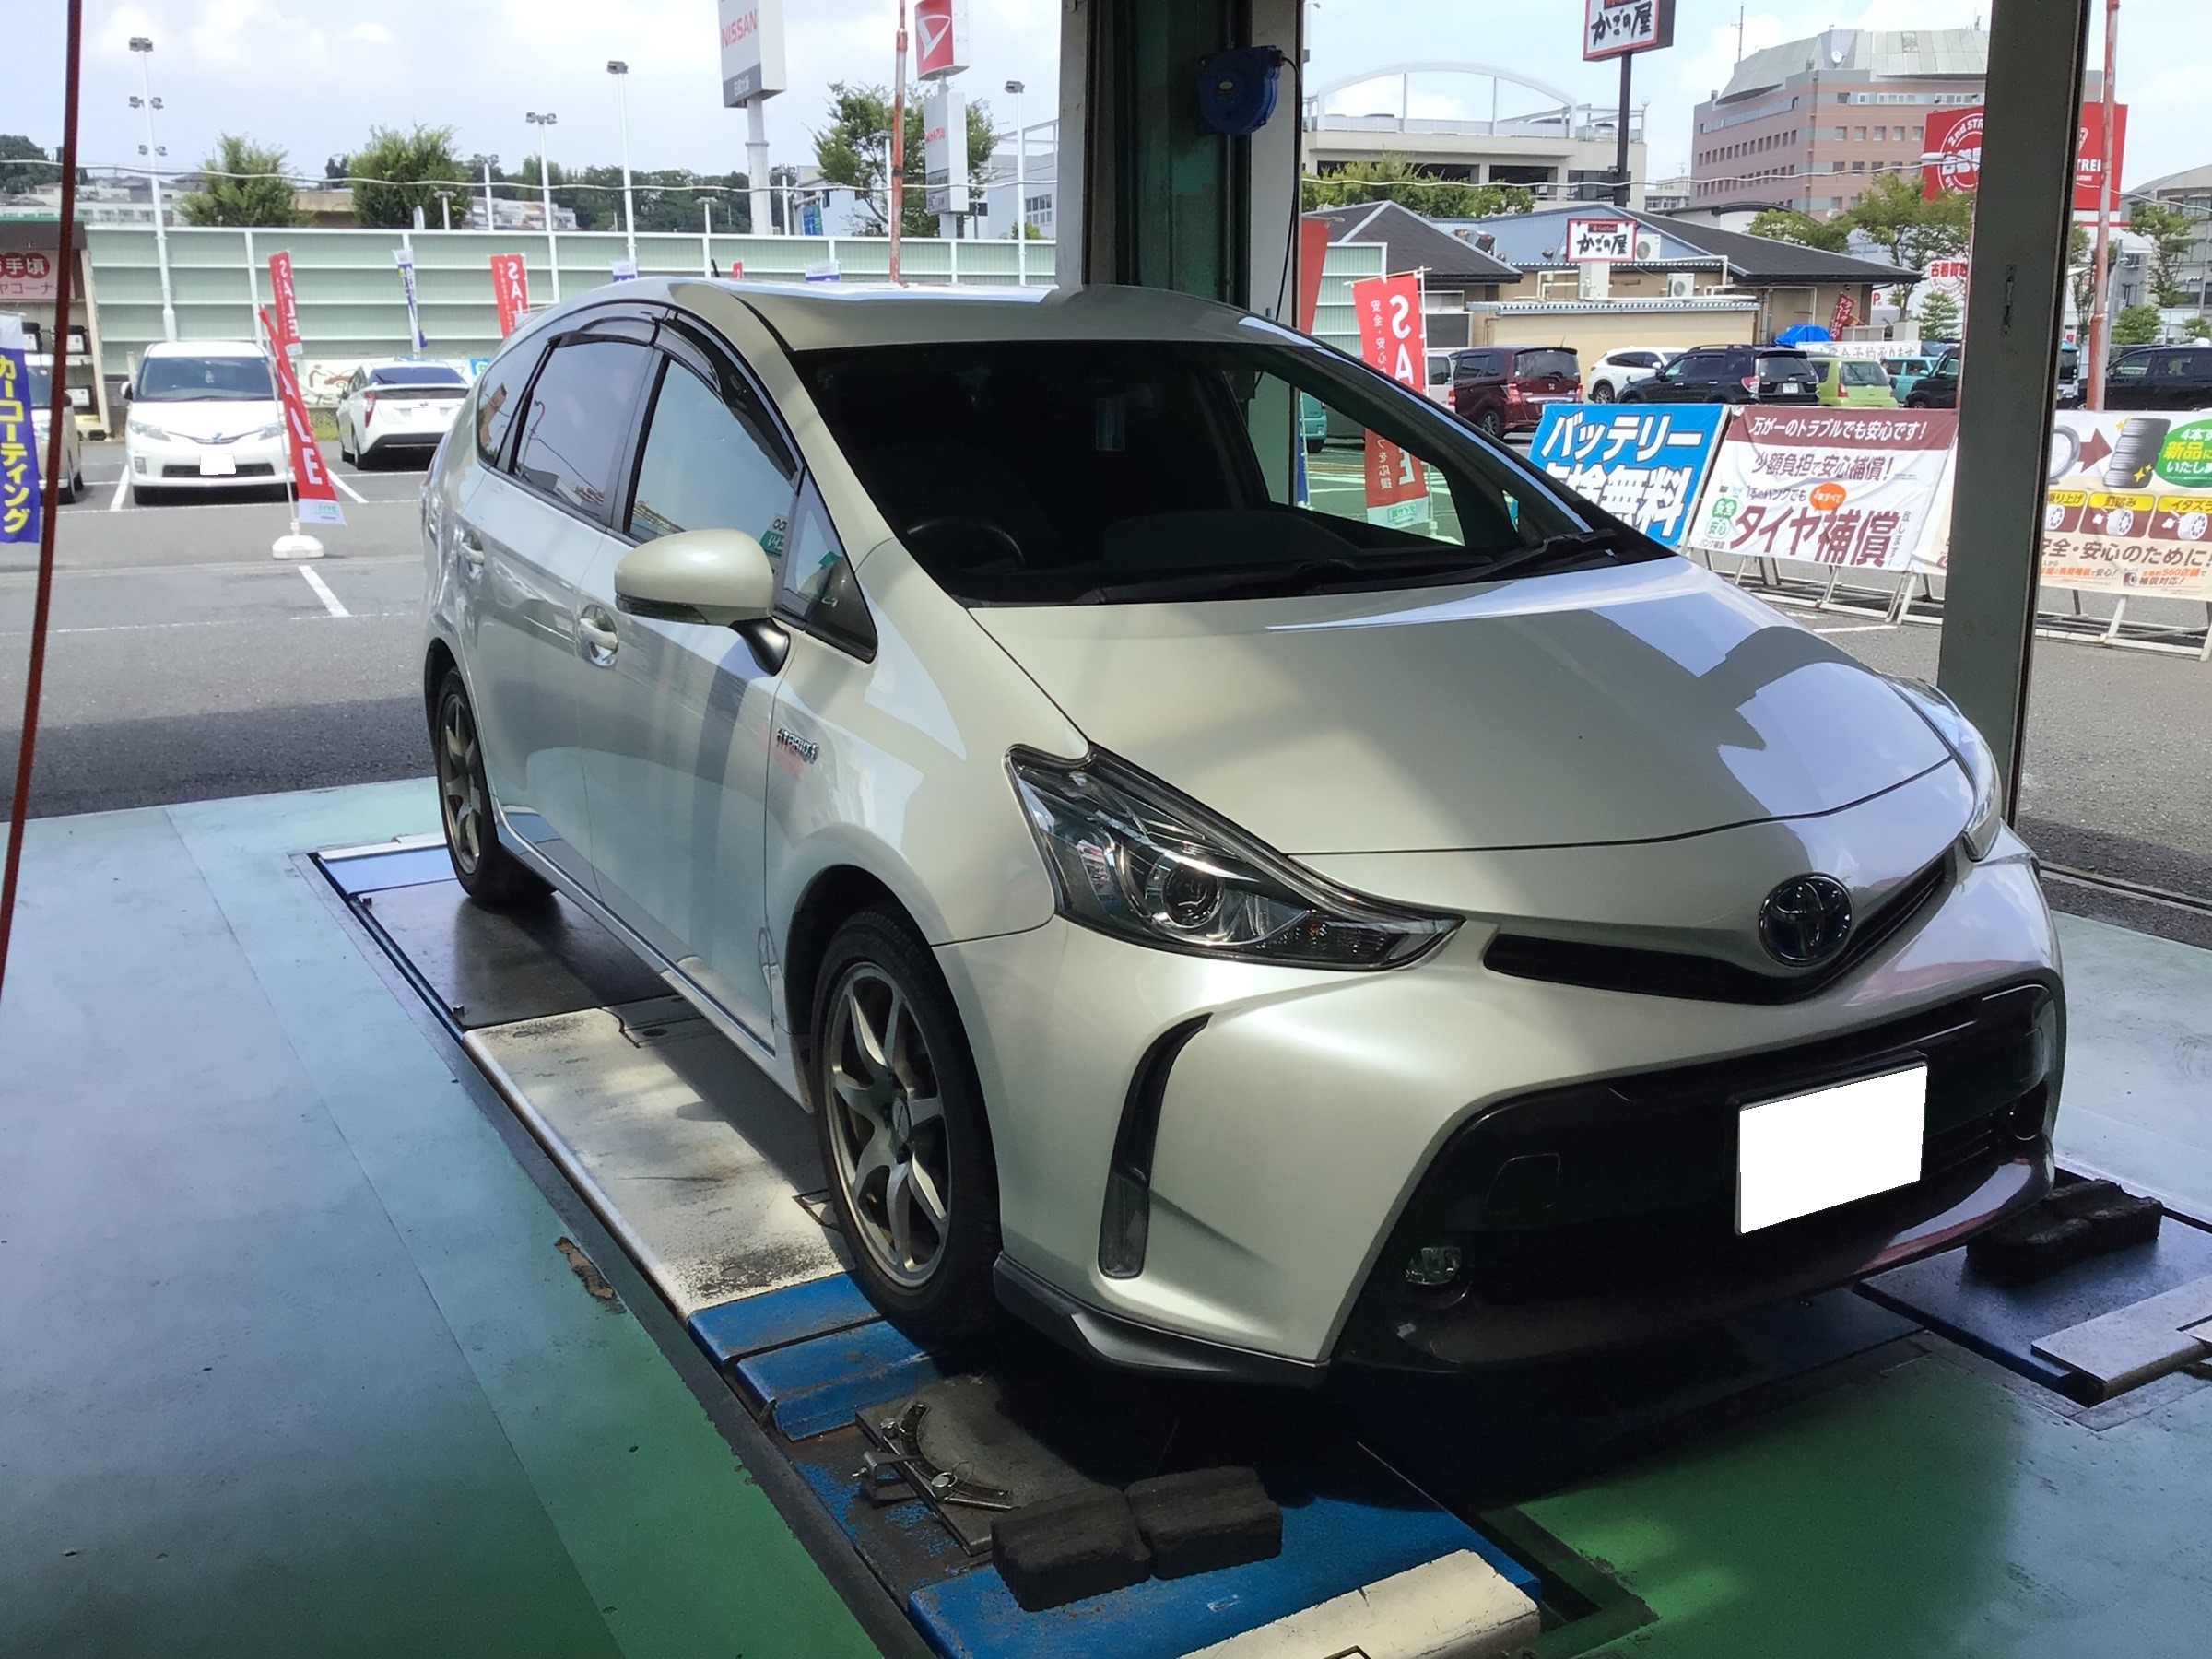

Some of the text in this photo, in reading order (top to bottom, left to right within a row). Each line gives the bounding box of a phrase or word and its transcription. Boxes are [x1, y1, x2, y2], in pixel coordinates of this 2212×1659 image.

[721, 8, 758, 49] NISSAN
[1591, 1, 1653, 45] かごの屋
[1947, 123, 1967, 147] 2nd
[1576, 233, 1628, 255] かごの屋
[0, 257, 45, 275] 手頃
[0, 282, 57, 295] ヤコーナ
[279, 369, 323, 486] ALE
[1540, 409, 1703, 462] バッテリー
[0, 354, 31, 533] カーコーティング
[1714, 499, 1736, 515] 安全
[2171, 499, 2212, 512] イタズラ
[1707, 520, 1728, 537] 安心
[1730, 506, 1900, 569] タイヤ補償
